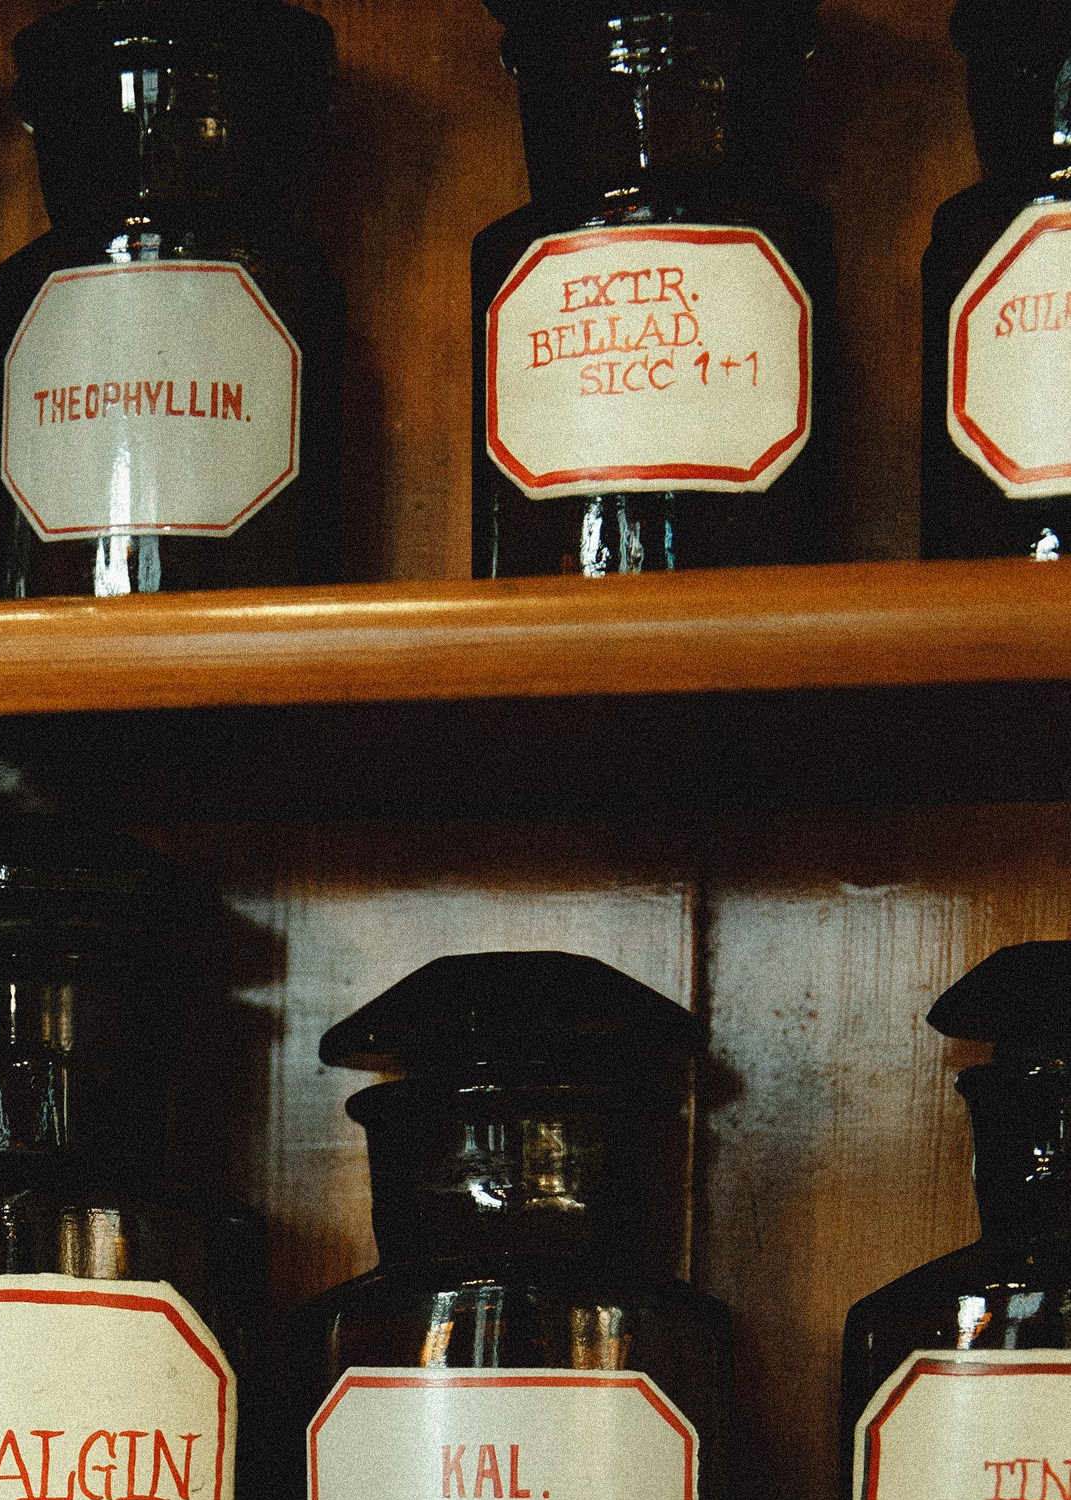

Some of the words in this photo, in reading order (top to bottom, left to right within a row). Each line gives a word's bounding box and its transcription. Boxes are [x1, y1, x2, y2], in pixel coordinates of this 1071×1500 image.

[560, 267, 699, 314] EXTR.
[528, 311, 704, 370] BELLAD.
[580, 349, 675, 396] SICC
[33, 380, 252, 425] THEOPHYLLIN.
[440, 1443, 550, 1500] KAL.
